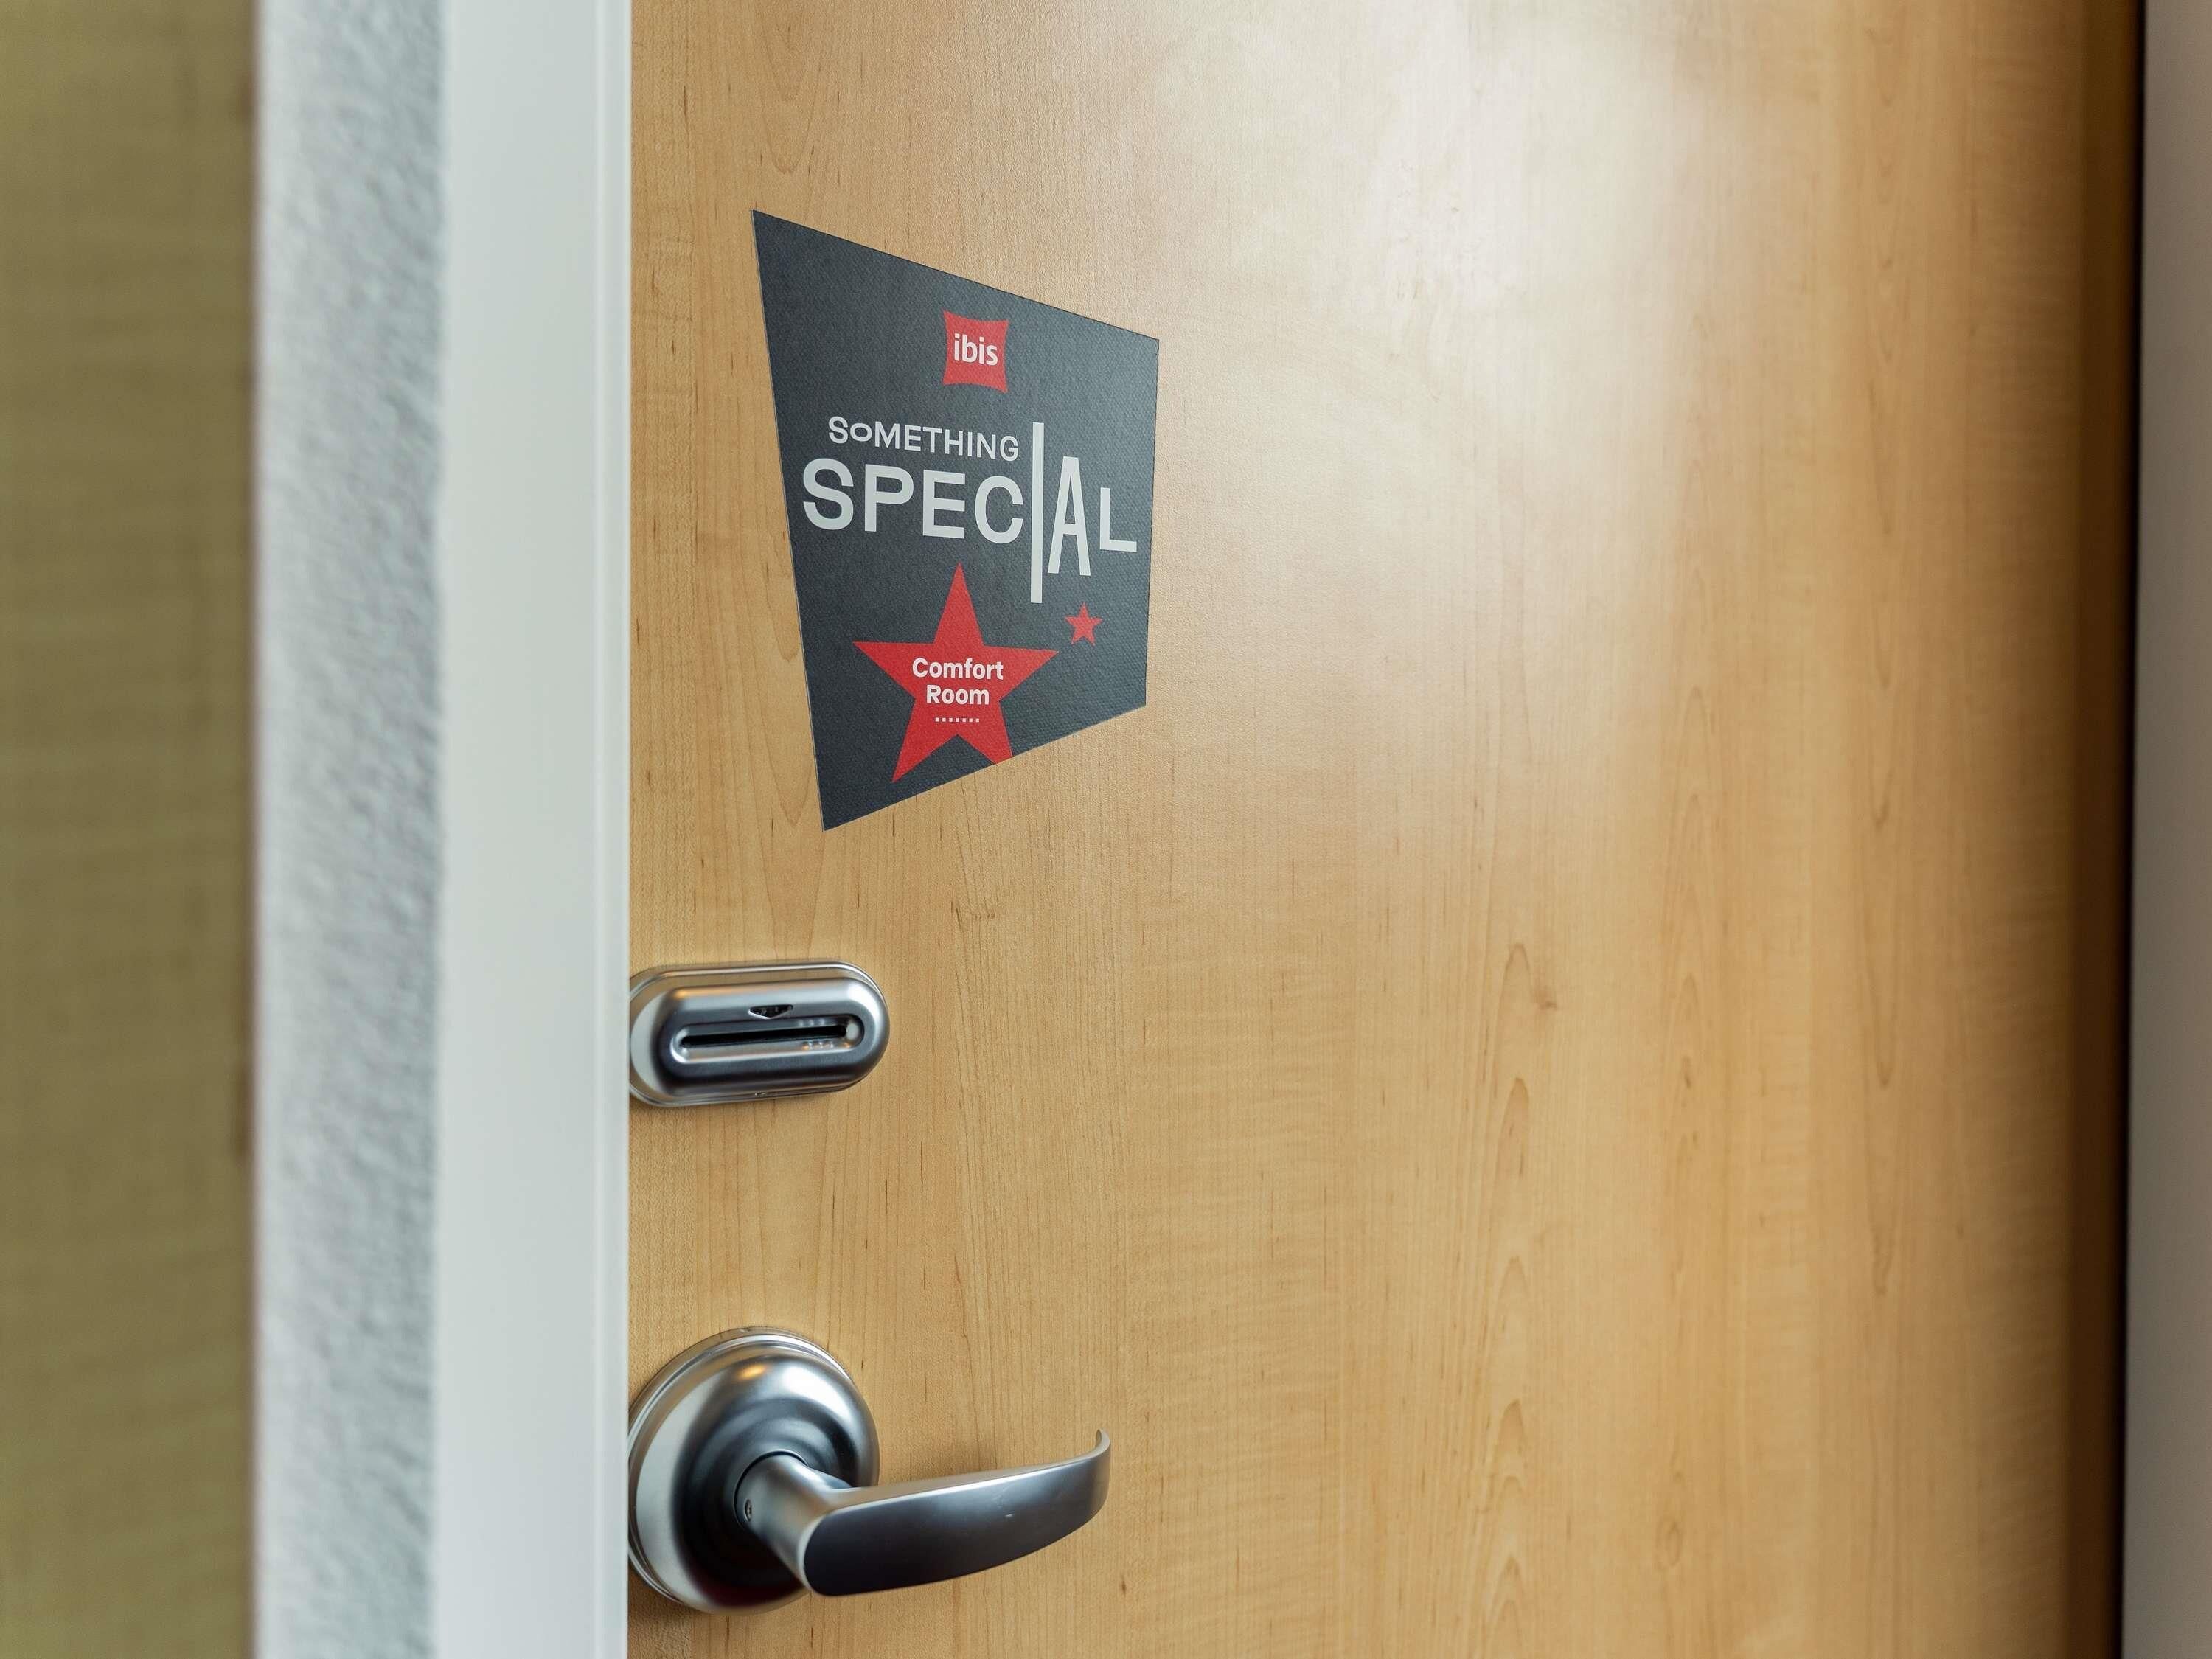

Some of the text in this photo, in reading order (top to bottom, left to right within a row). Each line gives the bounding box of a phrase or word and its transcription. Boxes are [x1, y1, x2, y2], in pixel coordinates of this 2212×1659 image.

[953, 333, 998, 366] ibis
[803, 422, 1137, 603] SPECIAL
[912, 657, 1004, 680] Comfort
[926, 684, 990, 705] Room
